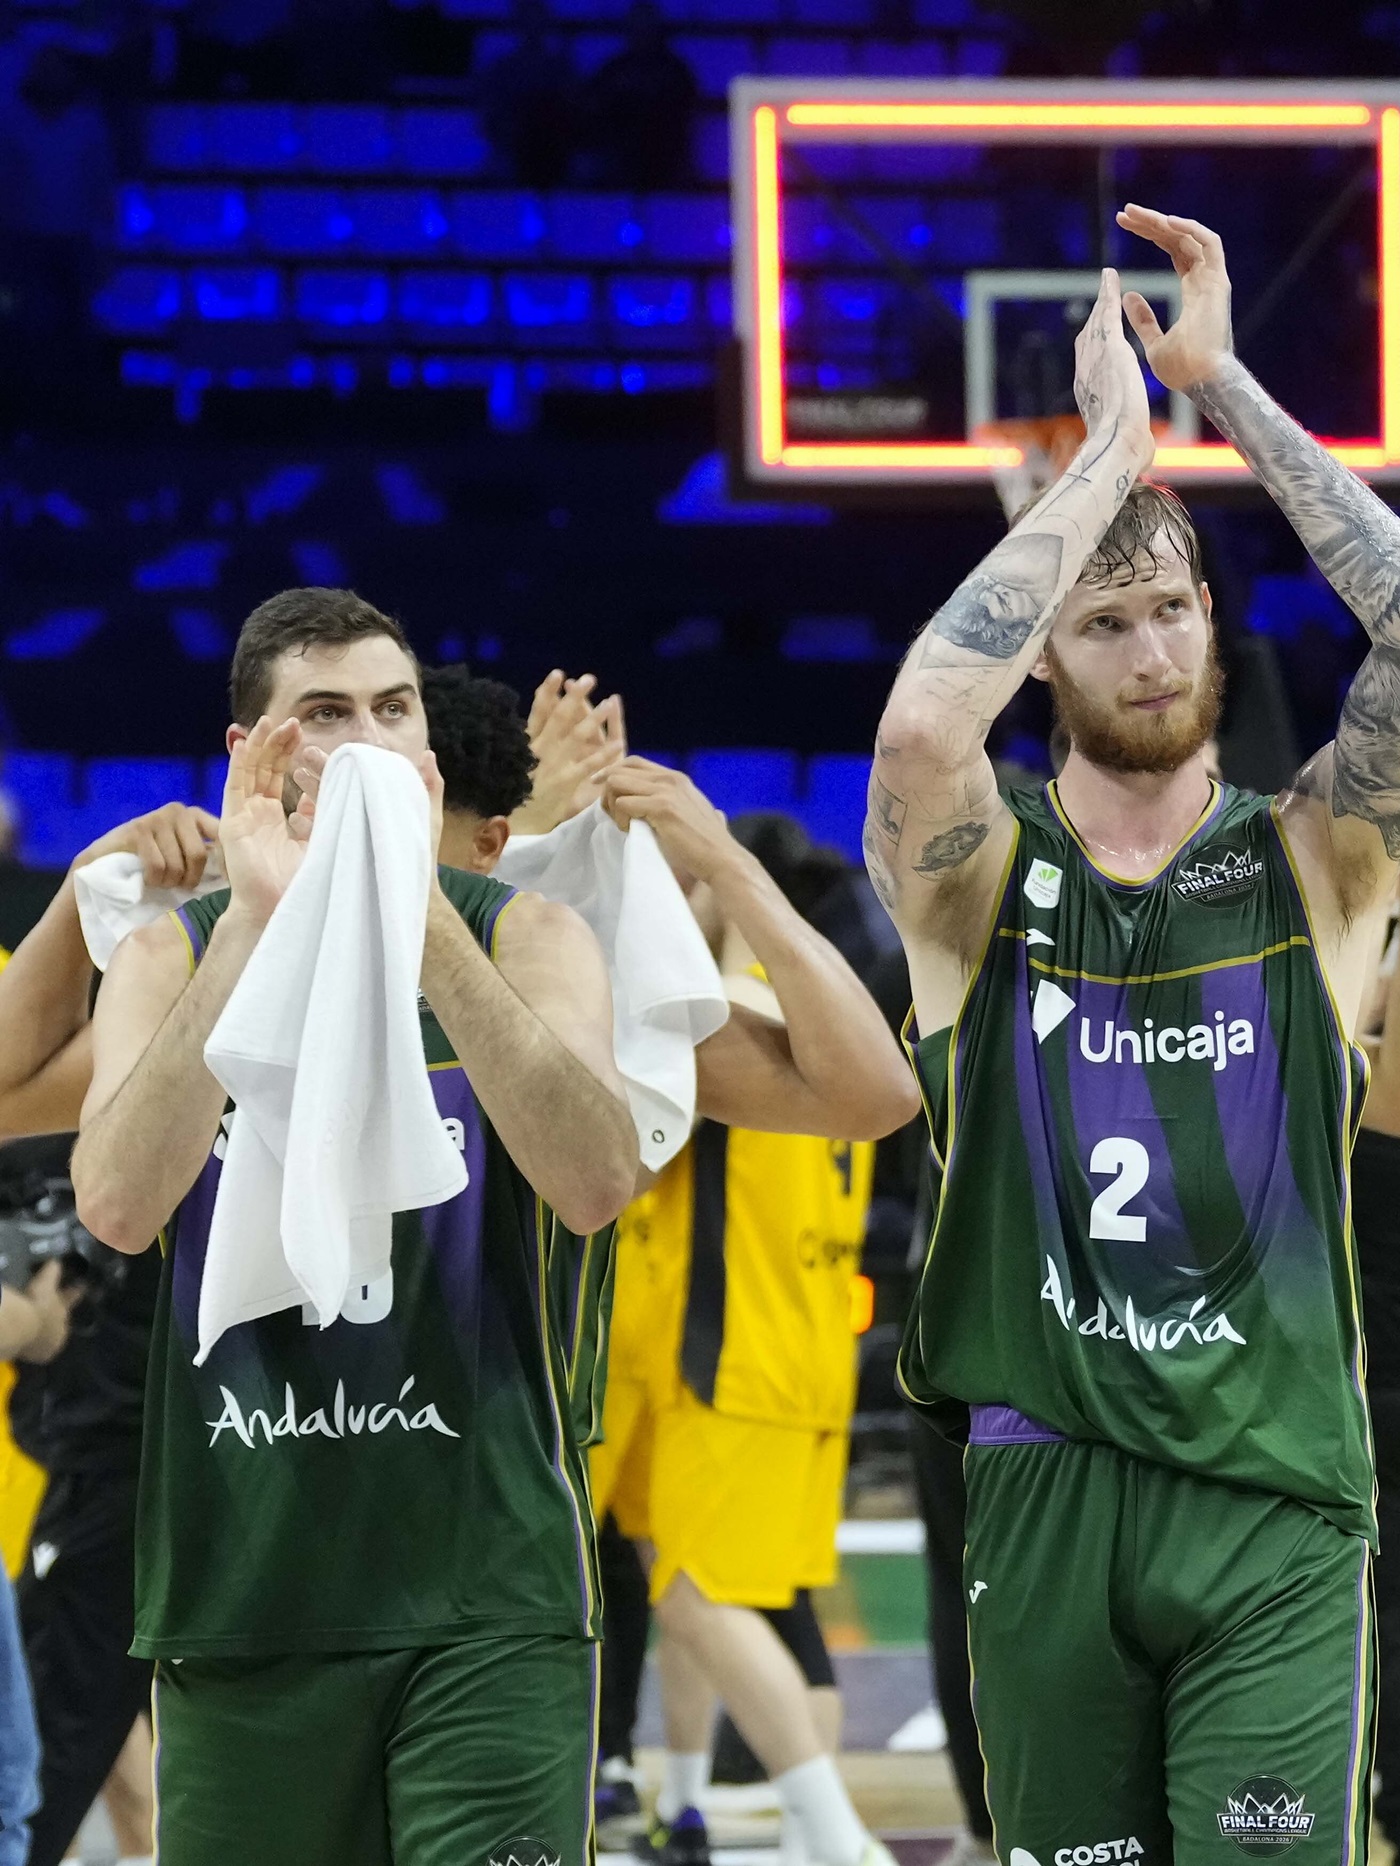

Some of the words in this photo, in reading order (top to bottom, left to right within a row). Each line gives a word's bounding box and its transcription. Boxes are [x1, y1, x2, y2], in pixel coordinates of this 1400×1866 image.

[1177, 874, 1225, 895] FINAL
[1224, 861, 1263, 881] FOUR
[1079, 1011, 1255, 1071] Unicaja
[1088, 1137, 1150, 1243] 2
[205, 1375, 461, 1450] Andalucía
[1221, 1815, 1267, 1829] FINAL
[1268, 1815, 1310, 1829] FOUR
[1054, 1836, 1145, 1866] COSTA
